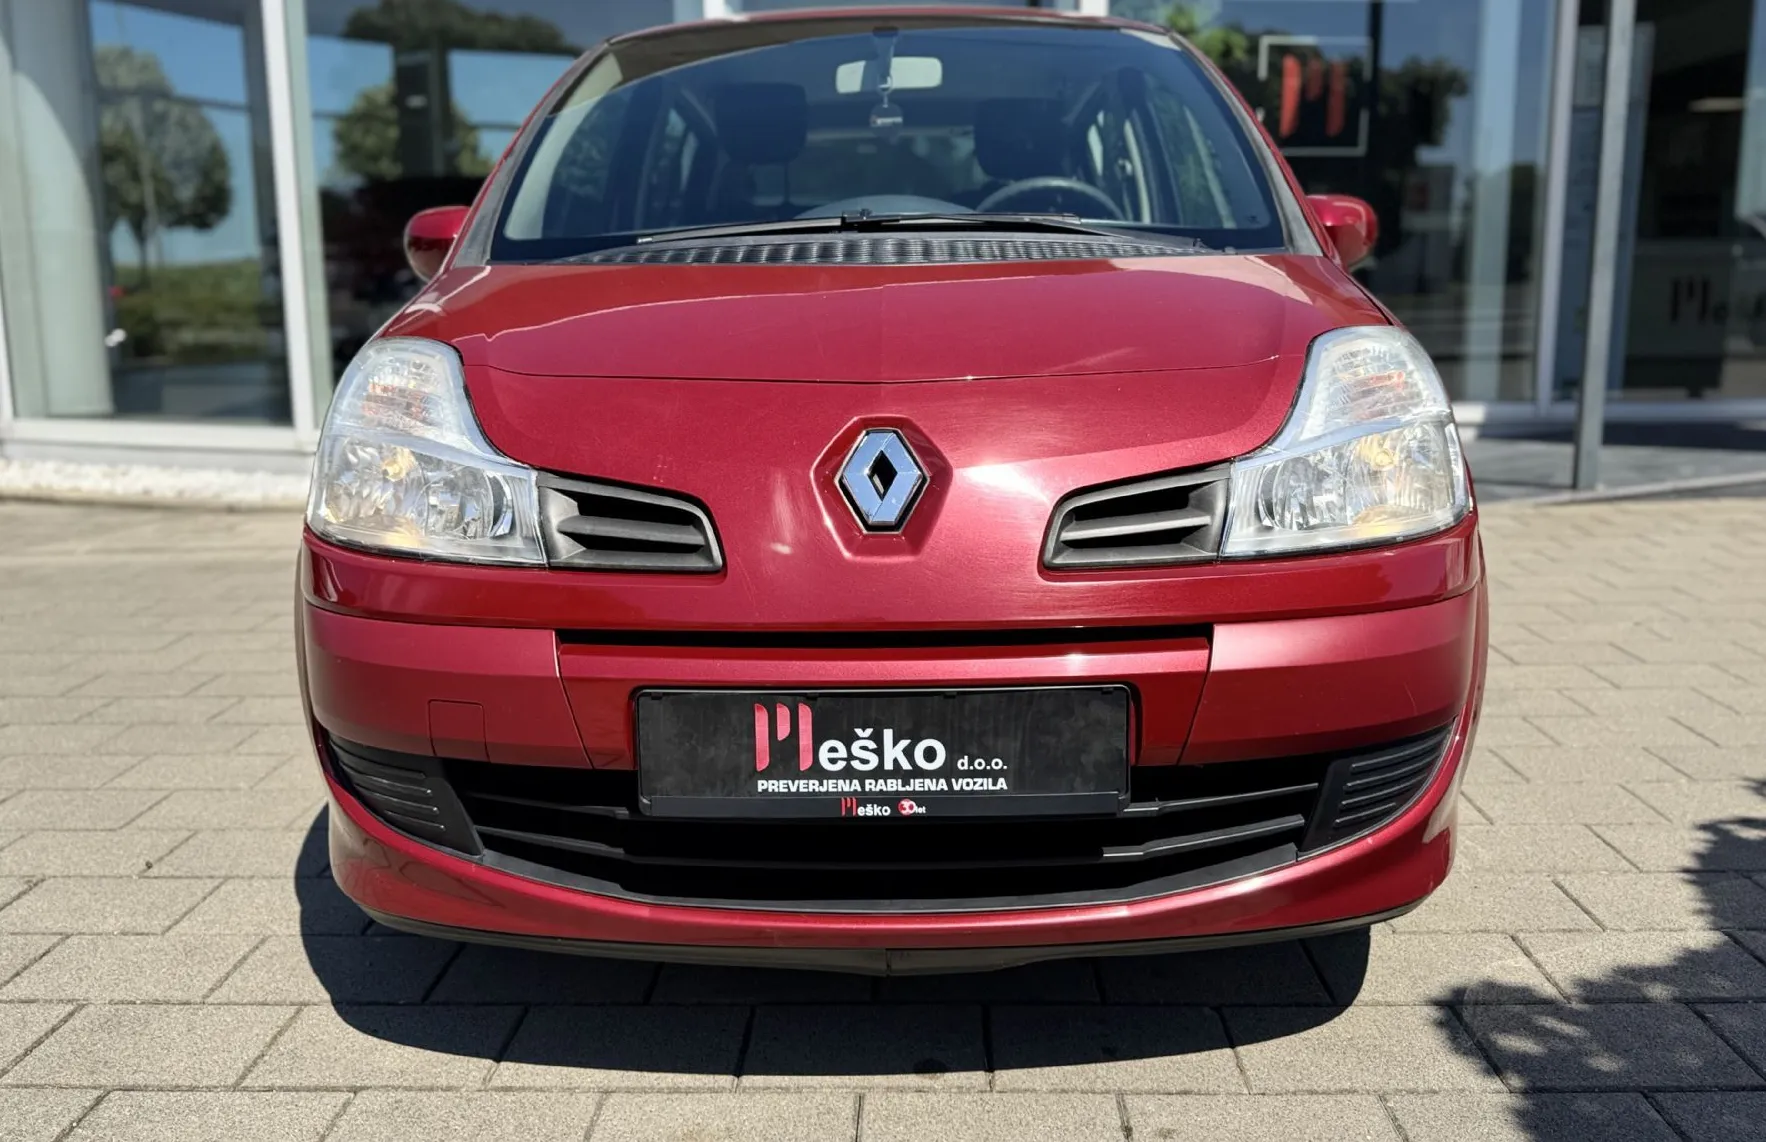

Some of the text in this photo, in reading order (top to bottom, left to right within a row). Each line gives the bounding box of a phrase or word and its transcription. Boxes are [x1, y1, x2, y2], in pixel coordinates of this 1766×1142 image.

[754, 702, 1009, 772] Meško d.o.o.
[757, 777, 1009, 793] PREVERJENA RABLJENA VOZILA
[841, 796, 892, 817] Meško
